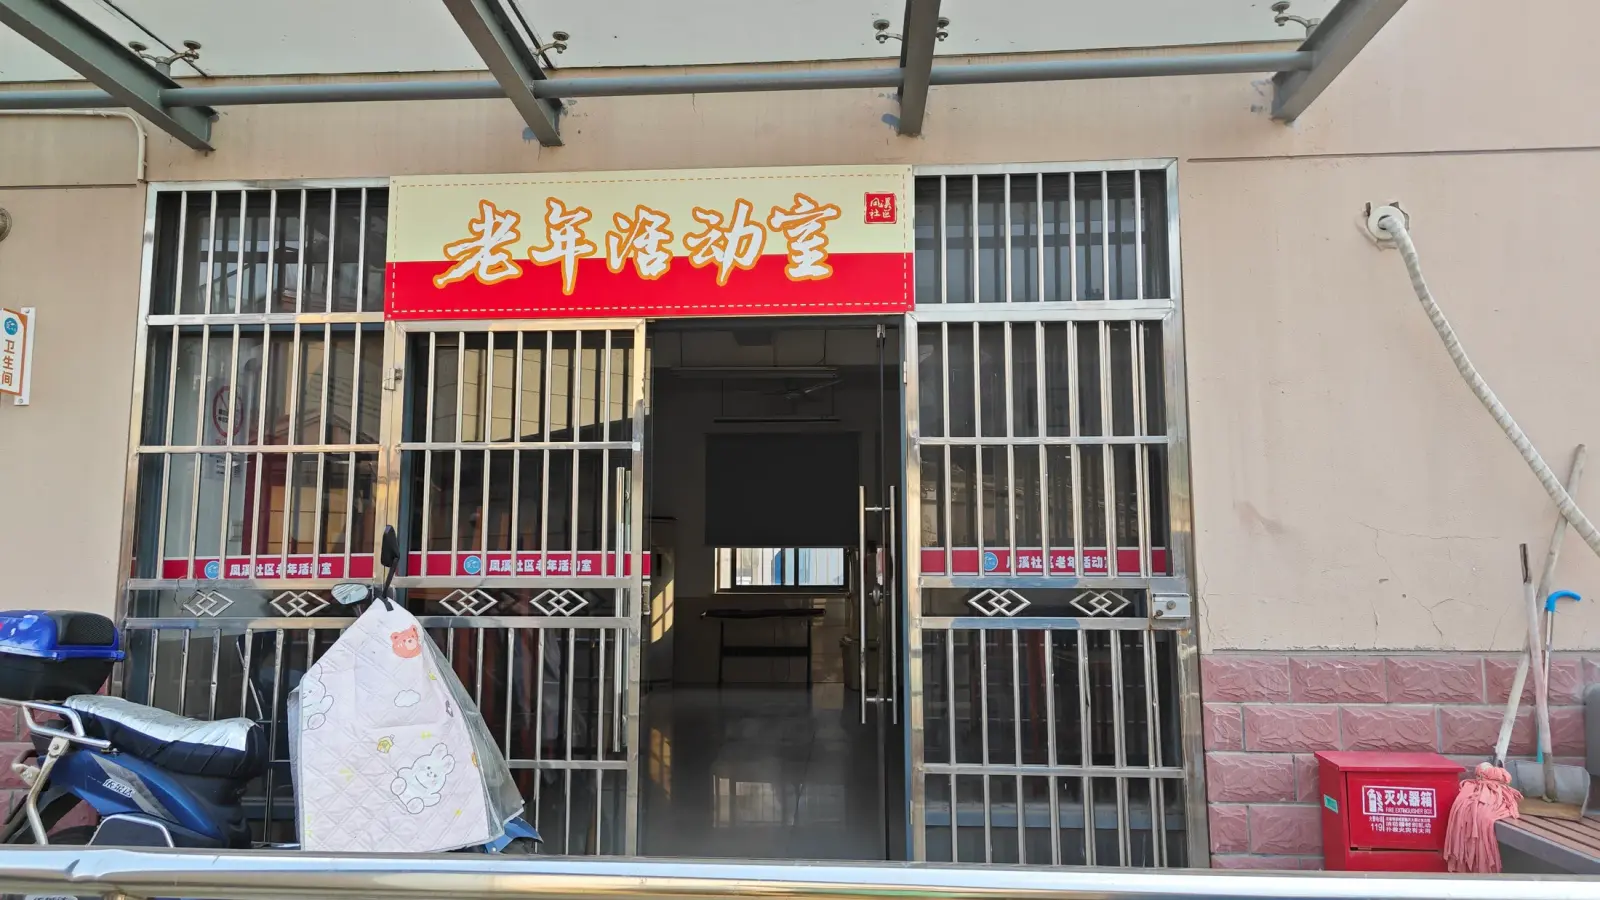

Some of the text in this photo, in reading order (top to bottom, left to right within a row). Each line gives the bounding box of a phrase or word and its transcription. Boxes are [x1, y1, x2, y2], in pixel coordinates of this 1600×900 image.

[434, 193, 839, 295] 老年活动室
[2, 339, 15, 386] 卫生间
[1006, 556, 1108, 569] 溪社老年活动
[1384, 790, 1432, 808] 灭火器箱
[1371, 823, 1382, 831] 119
